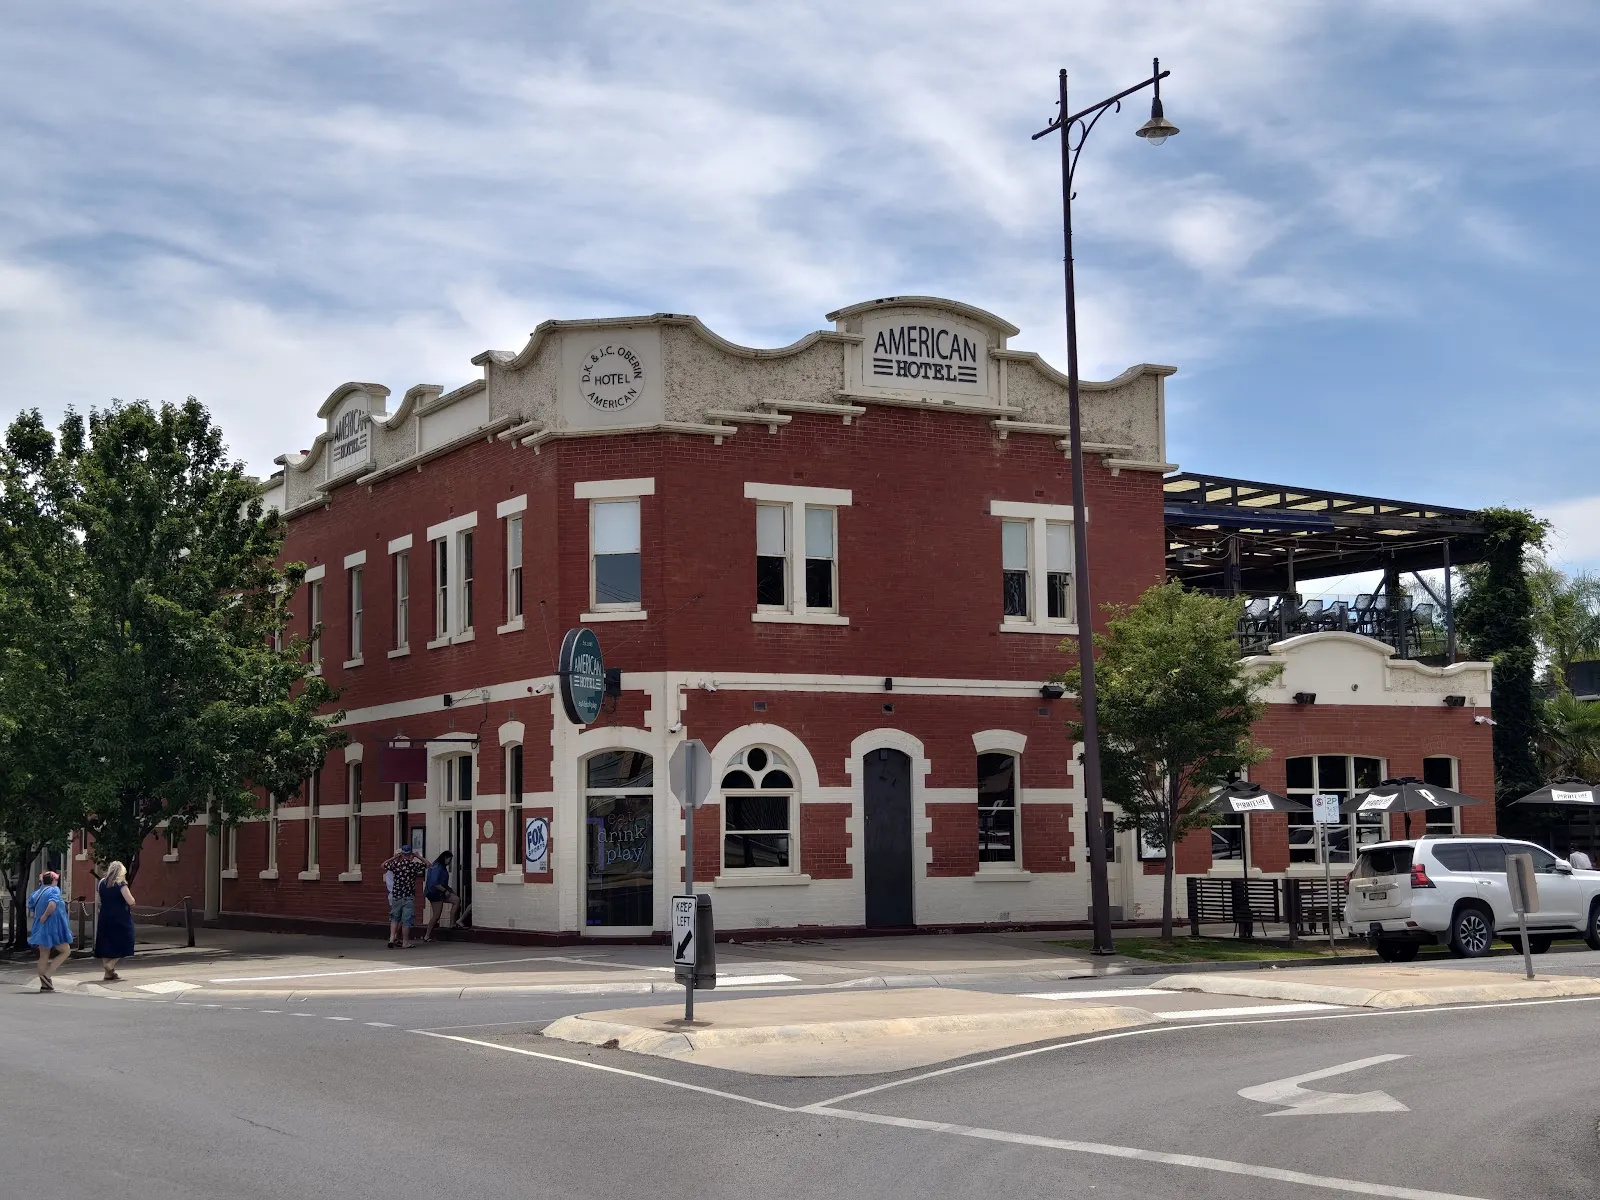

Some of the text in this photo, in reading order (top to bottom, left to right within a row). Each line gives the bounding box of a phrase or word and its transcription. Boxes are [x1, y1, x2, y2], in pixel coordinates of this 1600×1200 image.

[874, 326, 976, 363] AMERICAN
[617, 347, 642, 379] OBERIN
[895, 360, 957, 382] HOTEL
[595, 374, 630, 386] HOTEL
[588, 388, 637, 408] AMERICAN
[341, 438, 360, 460] HOTEL
[574, 654, 601, 676] AMERICAN
[579, 676, 597, 690] HOTEL
[1326, 797, 1337, 805] 2P
[528, 823, 545, 850] FOX
[598, 824, 647, 843] drink
[529, 842, 545, 857] SPORTS
[606, 844, 643, 865] play
[676, 901, 693, 913] KEEP
[676, 916, 691, 927] LEFT
